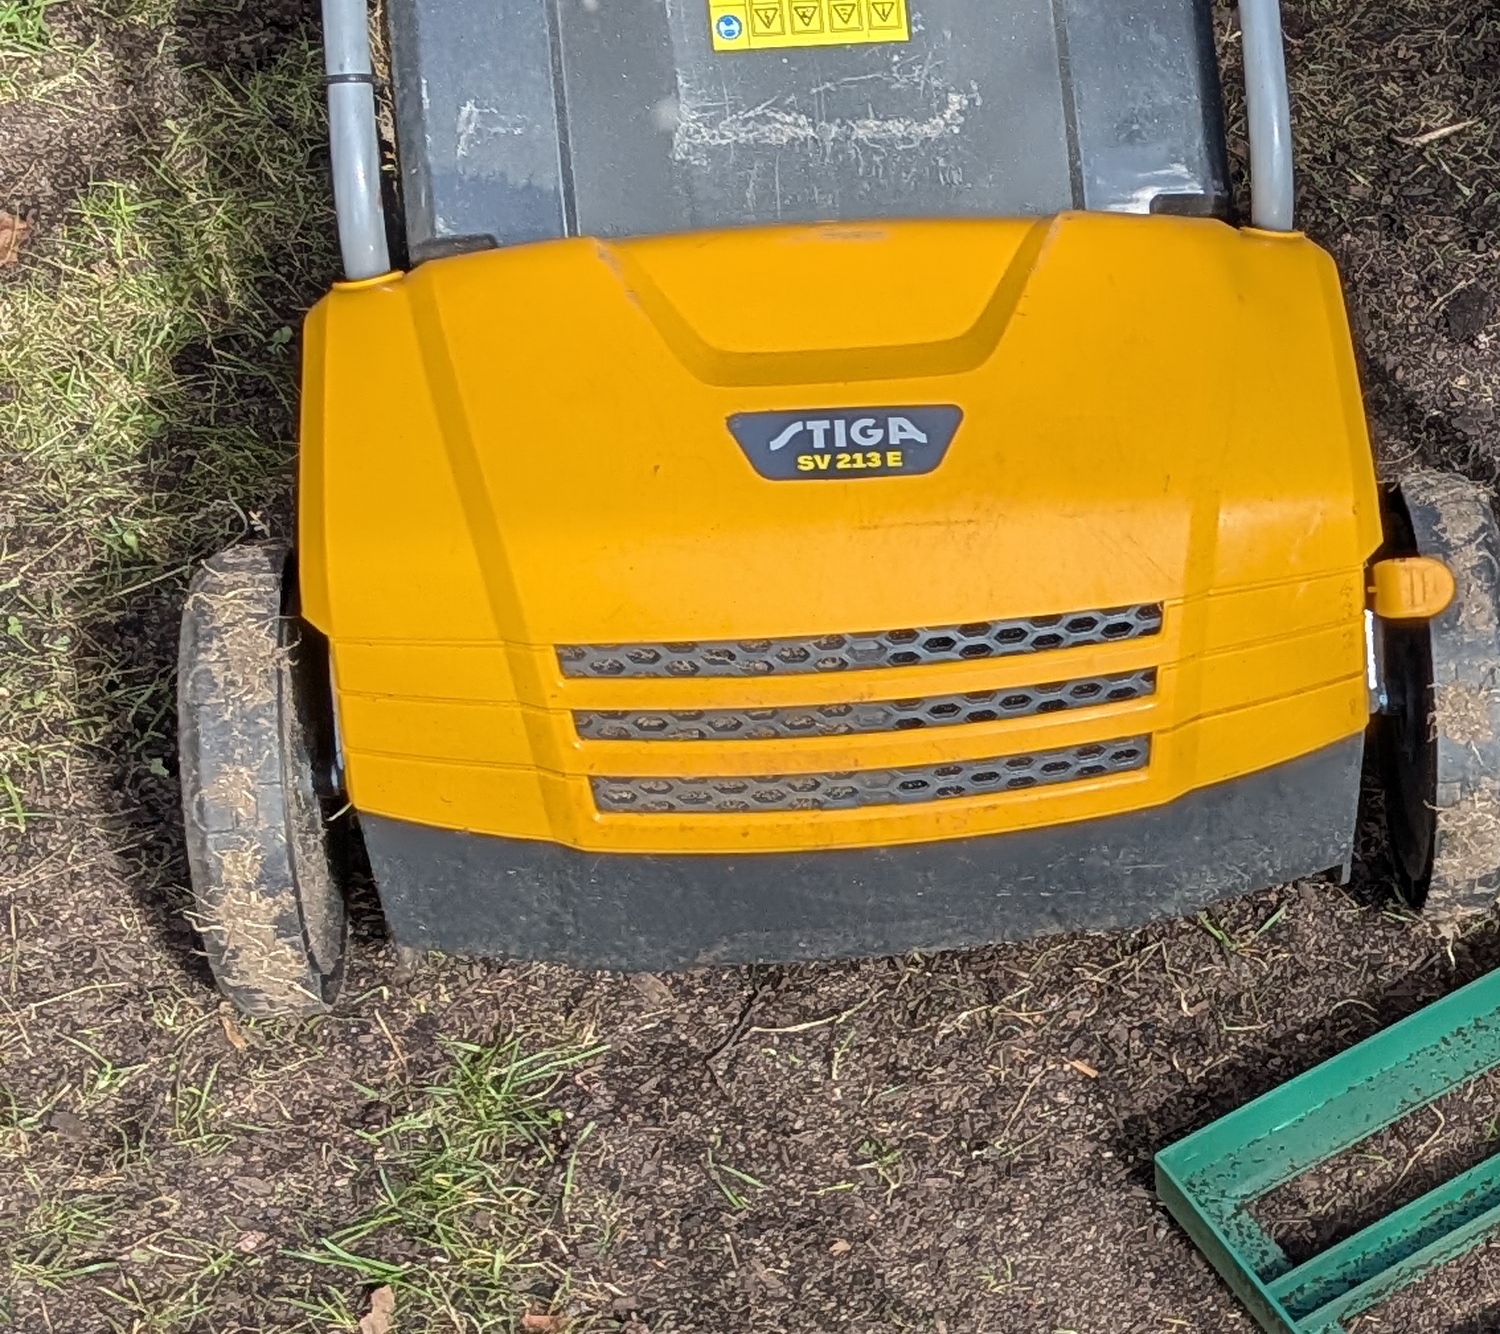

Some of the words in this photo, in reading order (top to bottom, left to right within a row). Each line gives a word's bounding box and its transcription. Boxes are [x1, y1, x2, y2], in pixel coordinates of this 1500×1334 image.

[769, 417, 928, 451] STIGA
[797, 454, 831, 471] SV
[836, 451, 882, 470] 213
[887, 451, 903, 467] E
